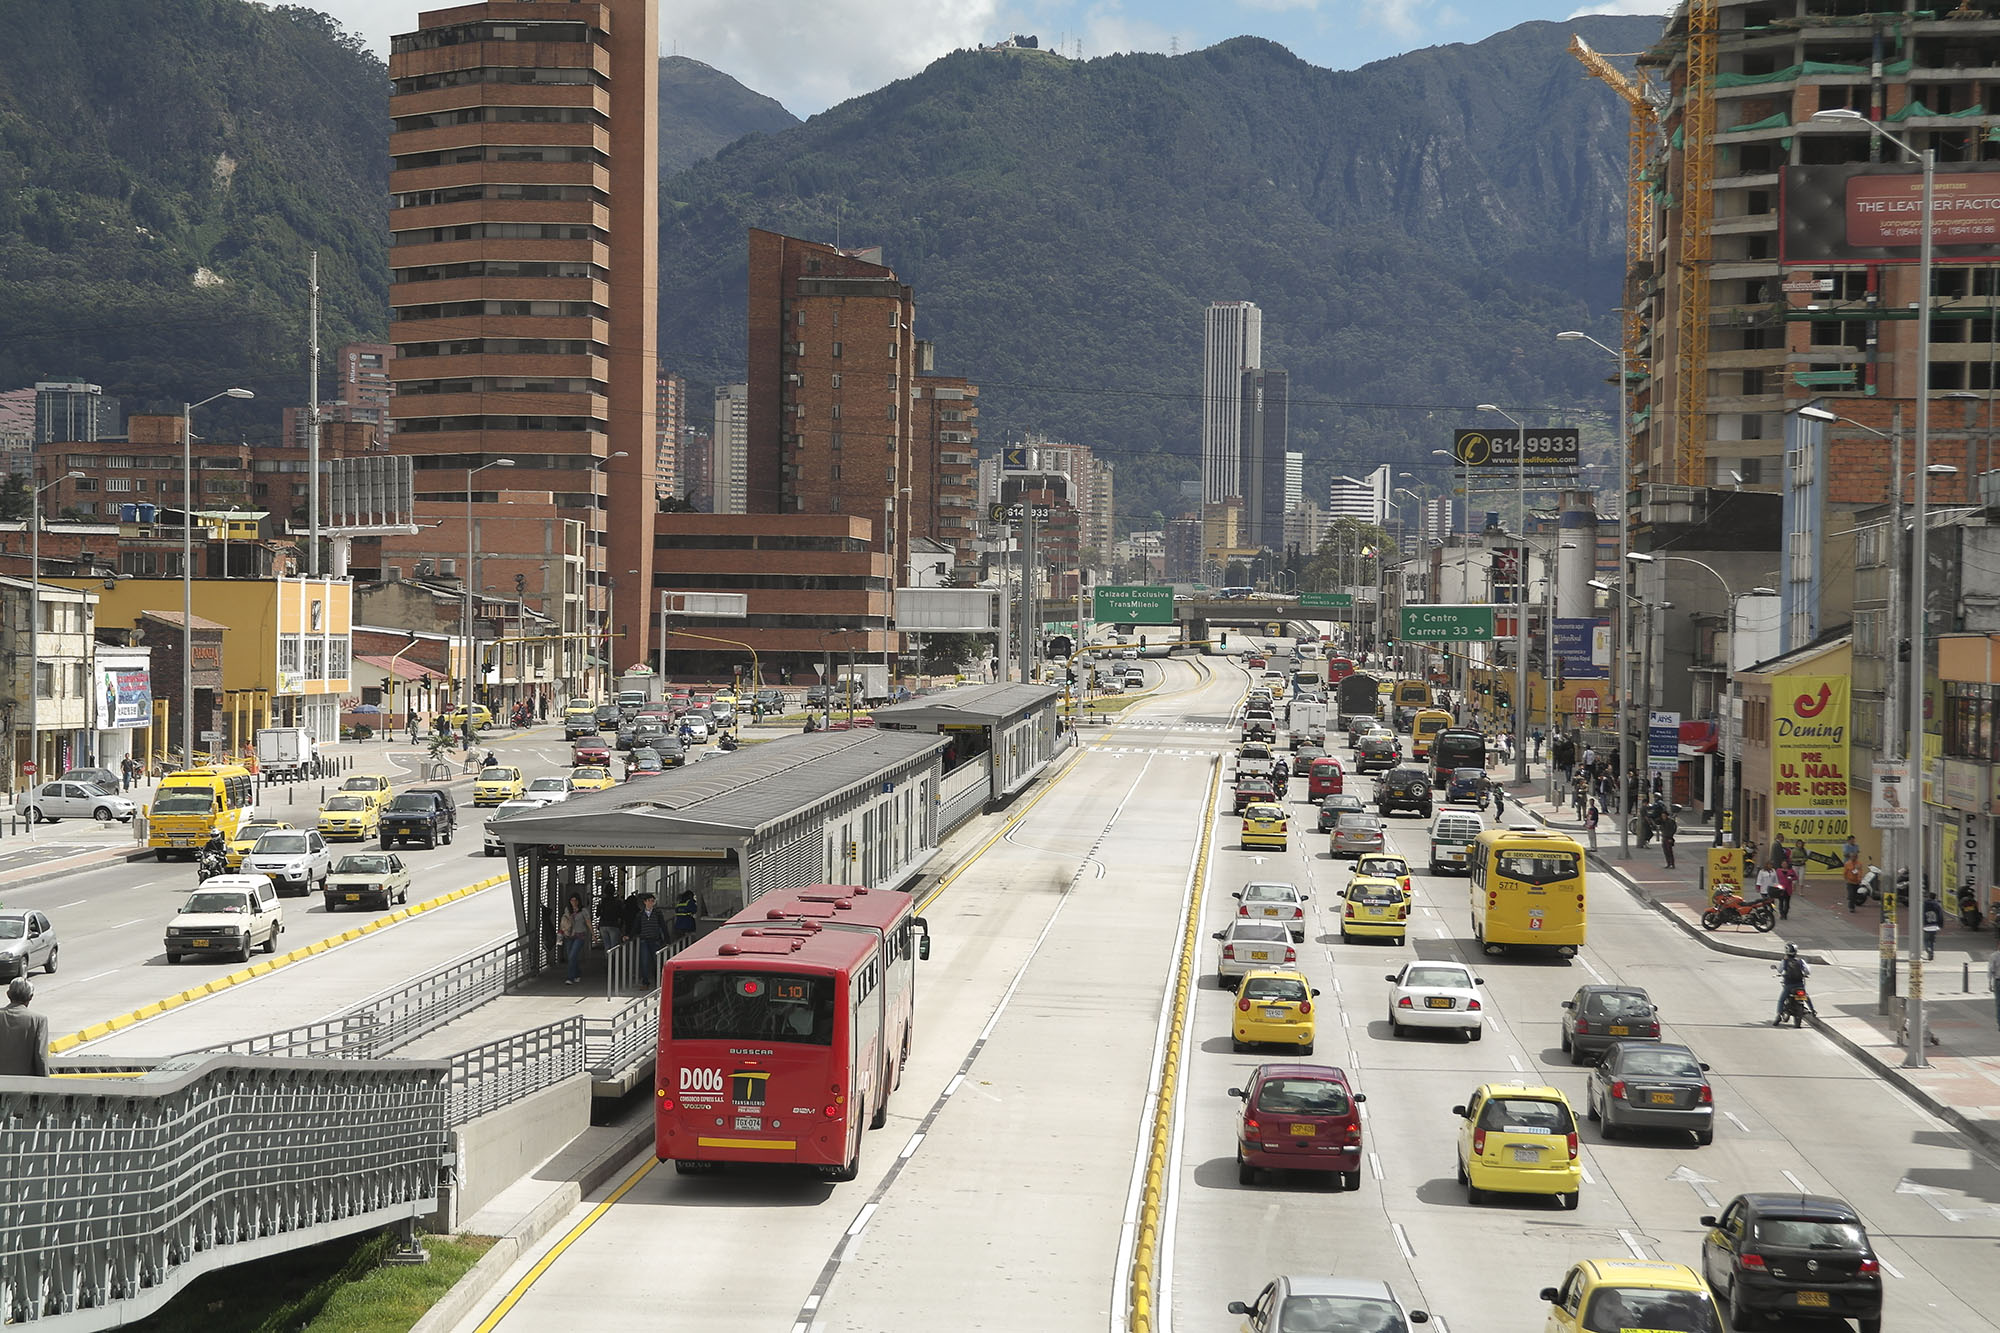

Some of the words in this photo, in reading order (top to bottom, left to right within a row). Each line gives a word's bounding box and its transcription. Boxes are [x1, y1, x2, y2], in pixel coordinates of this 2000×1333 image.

[1856, 202, 1886, 213] THE
[1491, 437, 1577, 453] 6149933
[1008, 508, 1049, 517] 614933
[1098, 590, 1129, 598] Calzada
[1131, 590, 1169, 598] Exclusiva
[1109, 600, 1159, 608] TransMilenio
[1423, 613, 1458, 622] Centro
[1408, 626, 1447, 636] Carrera
[1452, 626, 1469, 636] 33
[1774, 717, 1844, 743] Deming
[1801, 752, 1823, 763] PRE
[1780, 764, 1800, 779] U.
[1805, 763, 1843, 779] NAL
[1776, 782, 1801, 796] PRE
[1811, 782, 1848, 796] ICFES
[1793, 819, 1815, 835] 600
[1817, 819, 1825, 835] 9
[1827, 819, 1848, 835] 600
[1498, 881, 1519, 890] 5771
[777, 985, 803, 998] L10
[729, 1047, 774, 1056] BUSSCAR
[679, 1067, 723, 1091] D006
